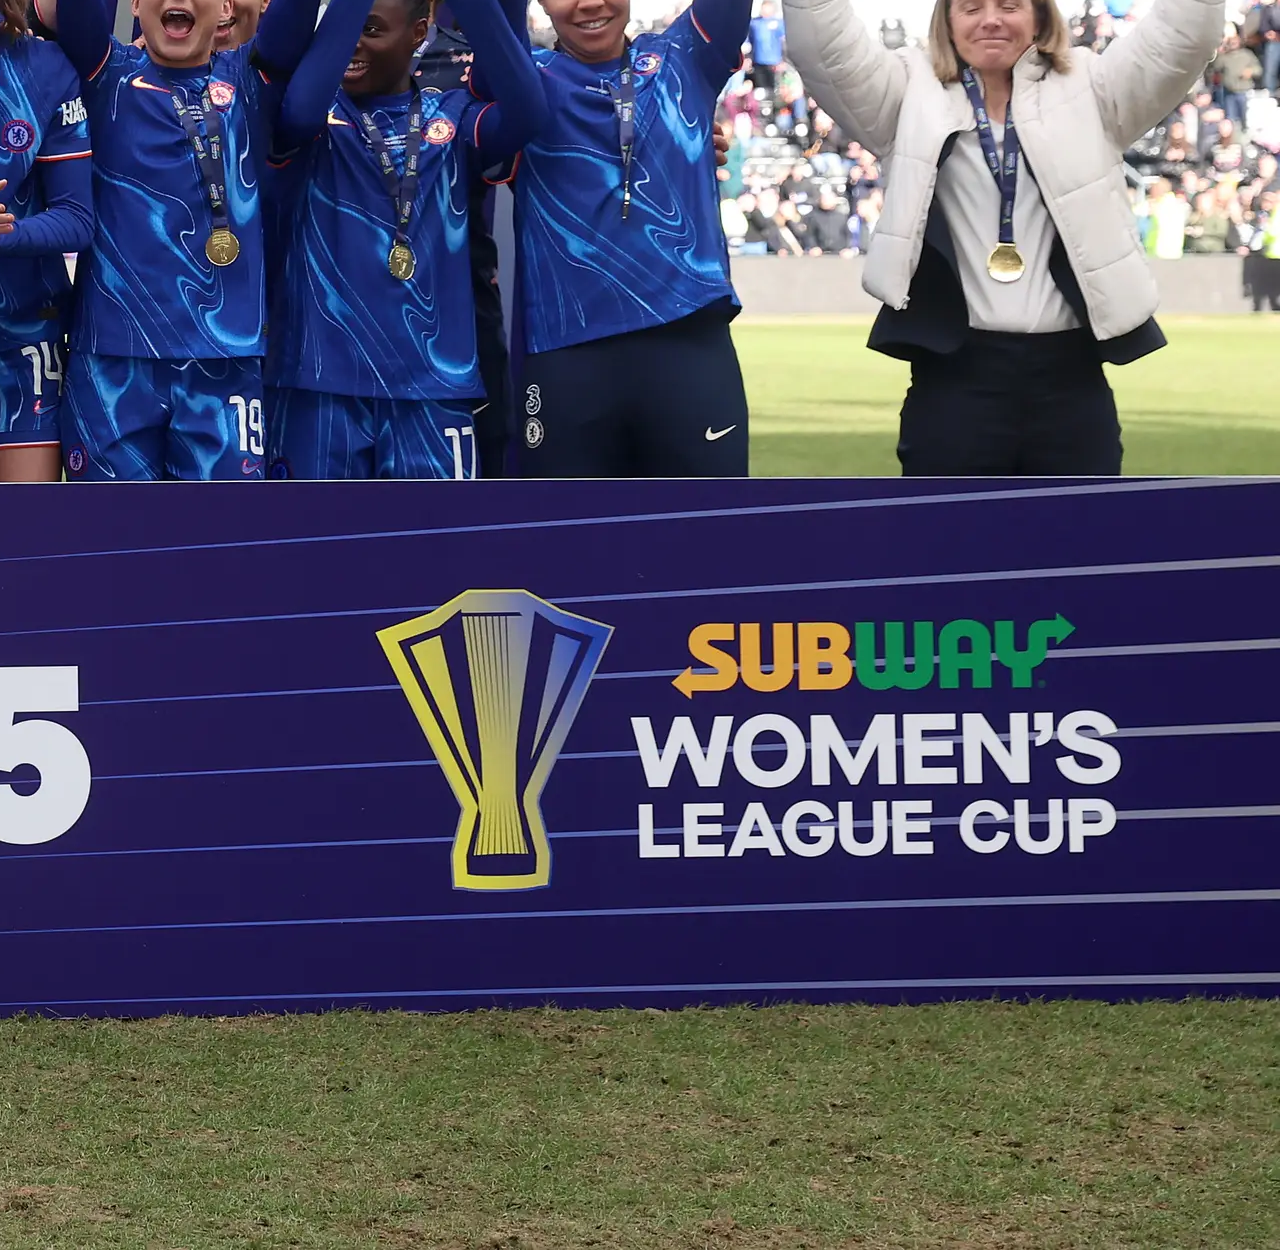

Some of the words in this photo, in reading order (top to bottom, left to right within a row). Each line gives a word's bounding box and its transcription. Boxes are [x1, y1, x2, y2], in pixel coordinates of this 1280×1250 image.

[61, 96, 83, 114] LIVE
[62, 108, 88, 126] NATI
[20, 341, 63, 397] 14
[229, 395, 264, 456] 19
[671, 612, 1076, 699] SUBWAY
[630, 709, 1122, 789] WOMEN'S
[639, 799, 934, 858] LEAGUE
[959, 796, 1118, 855] CUP
